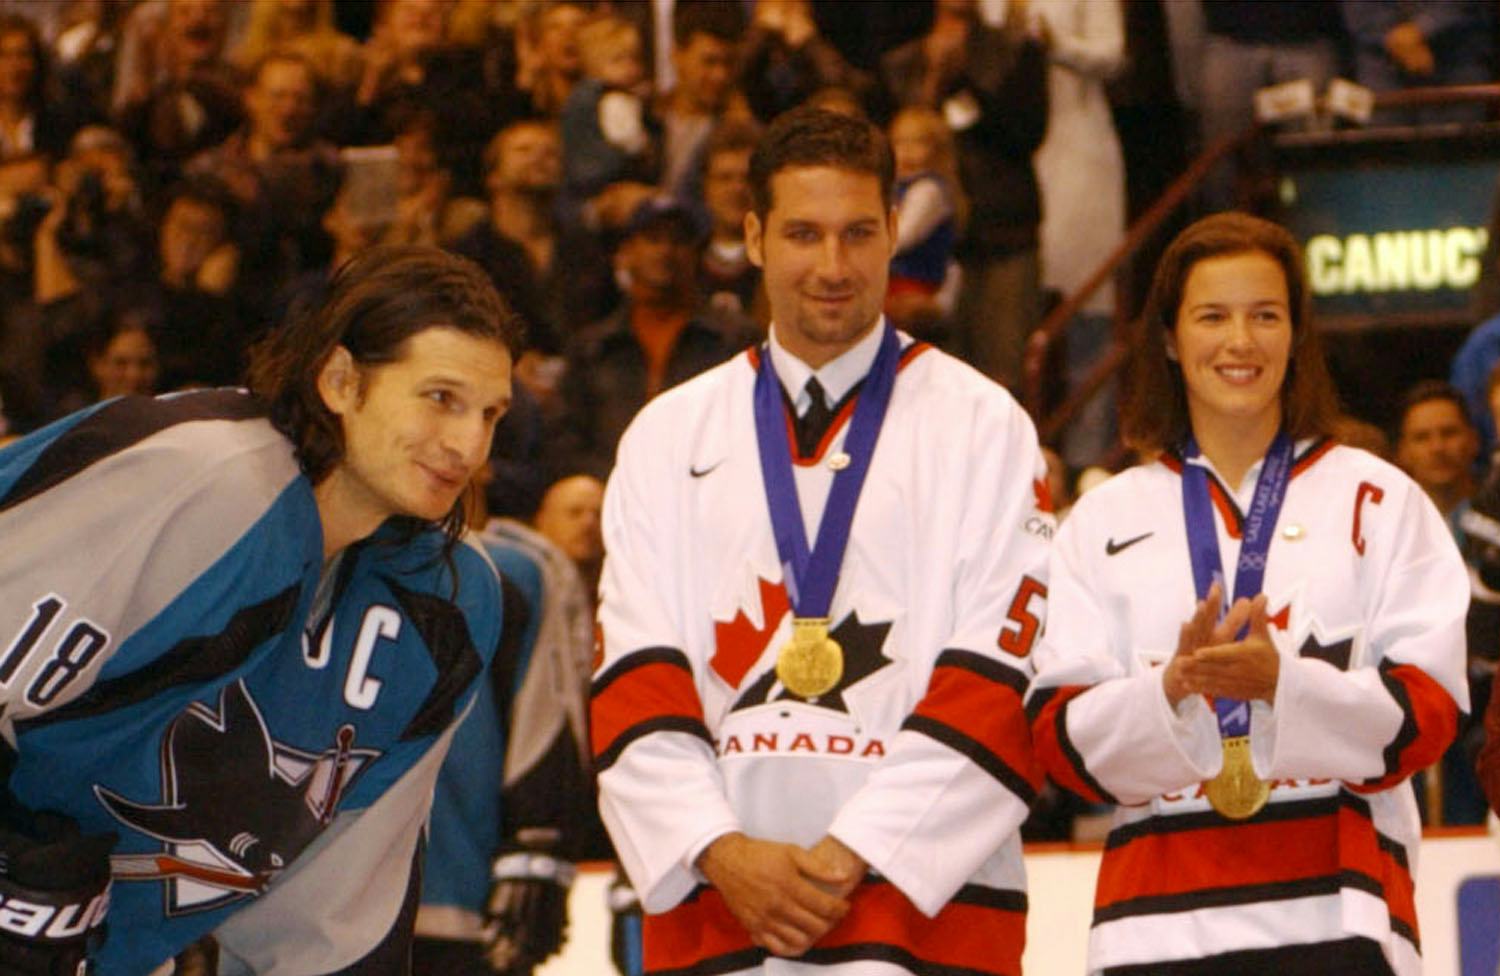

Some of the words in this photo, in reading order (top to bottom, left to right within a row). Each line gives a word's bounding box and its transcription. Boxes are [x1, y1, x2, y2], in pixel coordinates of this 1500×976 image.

[1352, 482, 1384, 556] C
[0, 592, 111, 709] 18
[344, 604, 402, 710] C
[713, 732, 886, 757] ANADA
